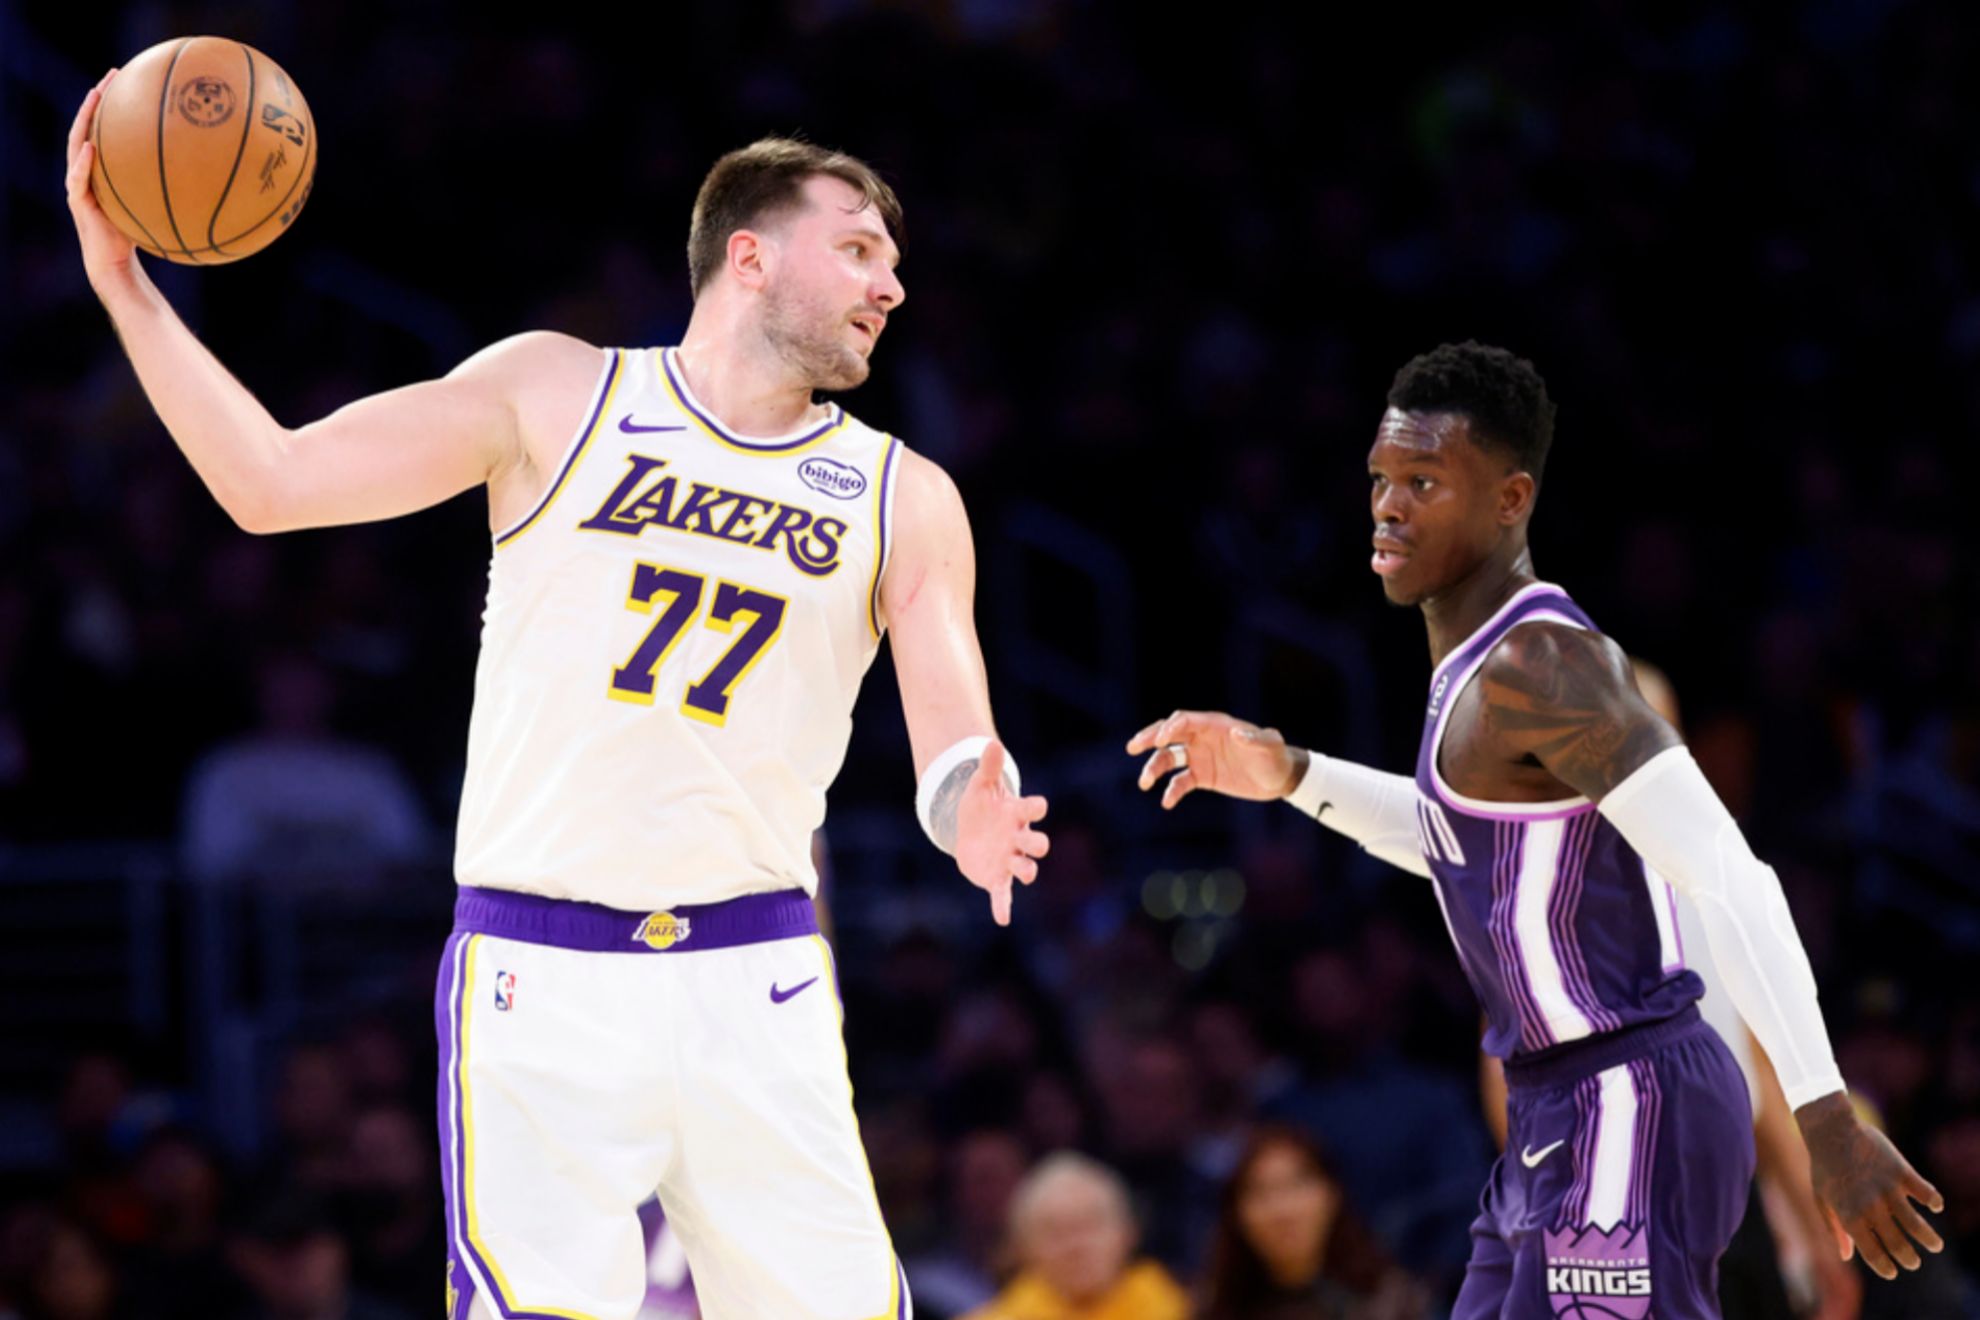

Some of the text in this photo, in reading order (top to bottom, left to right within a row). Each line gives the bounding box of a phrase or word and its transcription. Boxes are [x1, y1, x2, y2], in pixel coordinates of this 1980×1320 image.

[805, 464, 862, 490] bibigo
[578, 453, 847, 577] LAKERS
[607, 562, 790, 728] 77
[1549, 1256, 1647, 1267] SACRAMENTO
[1547, 1268, 1652, 1295] KINGS
